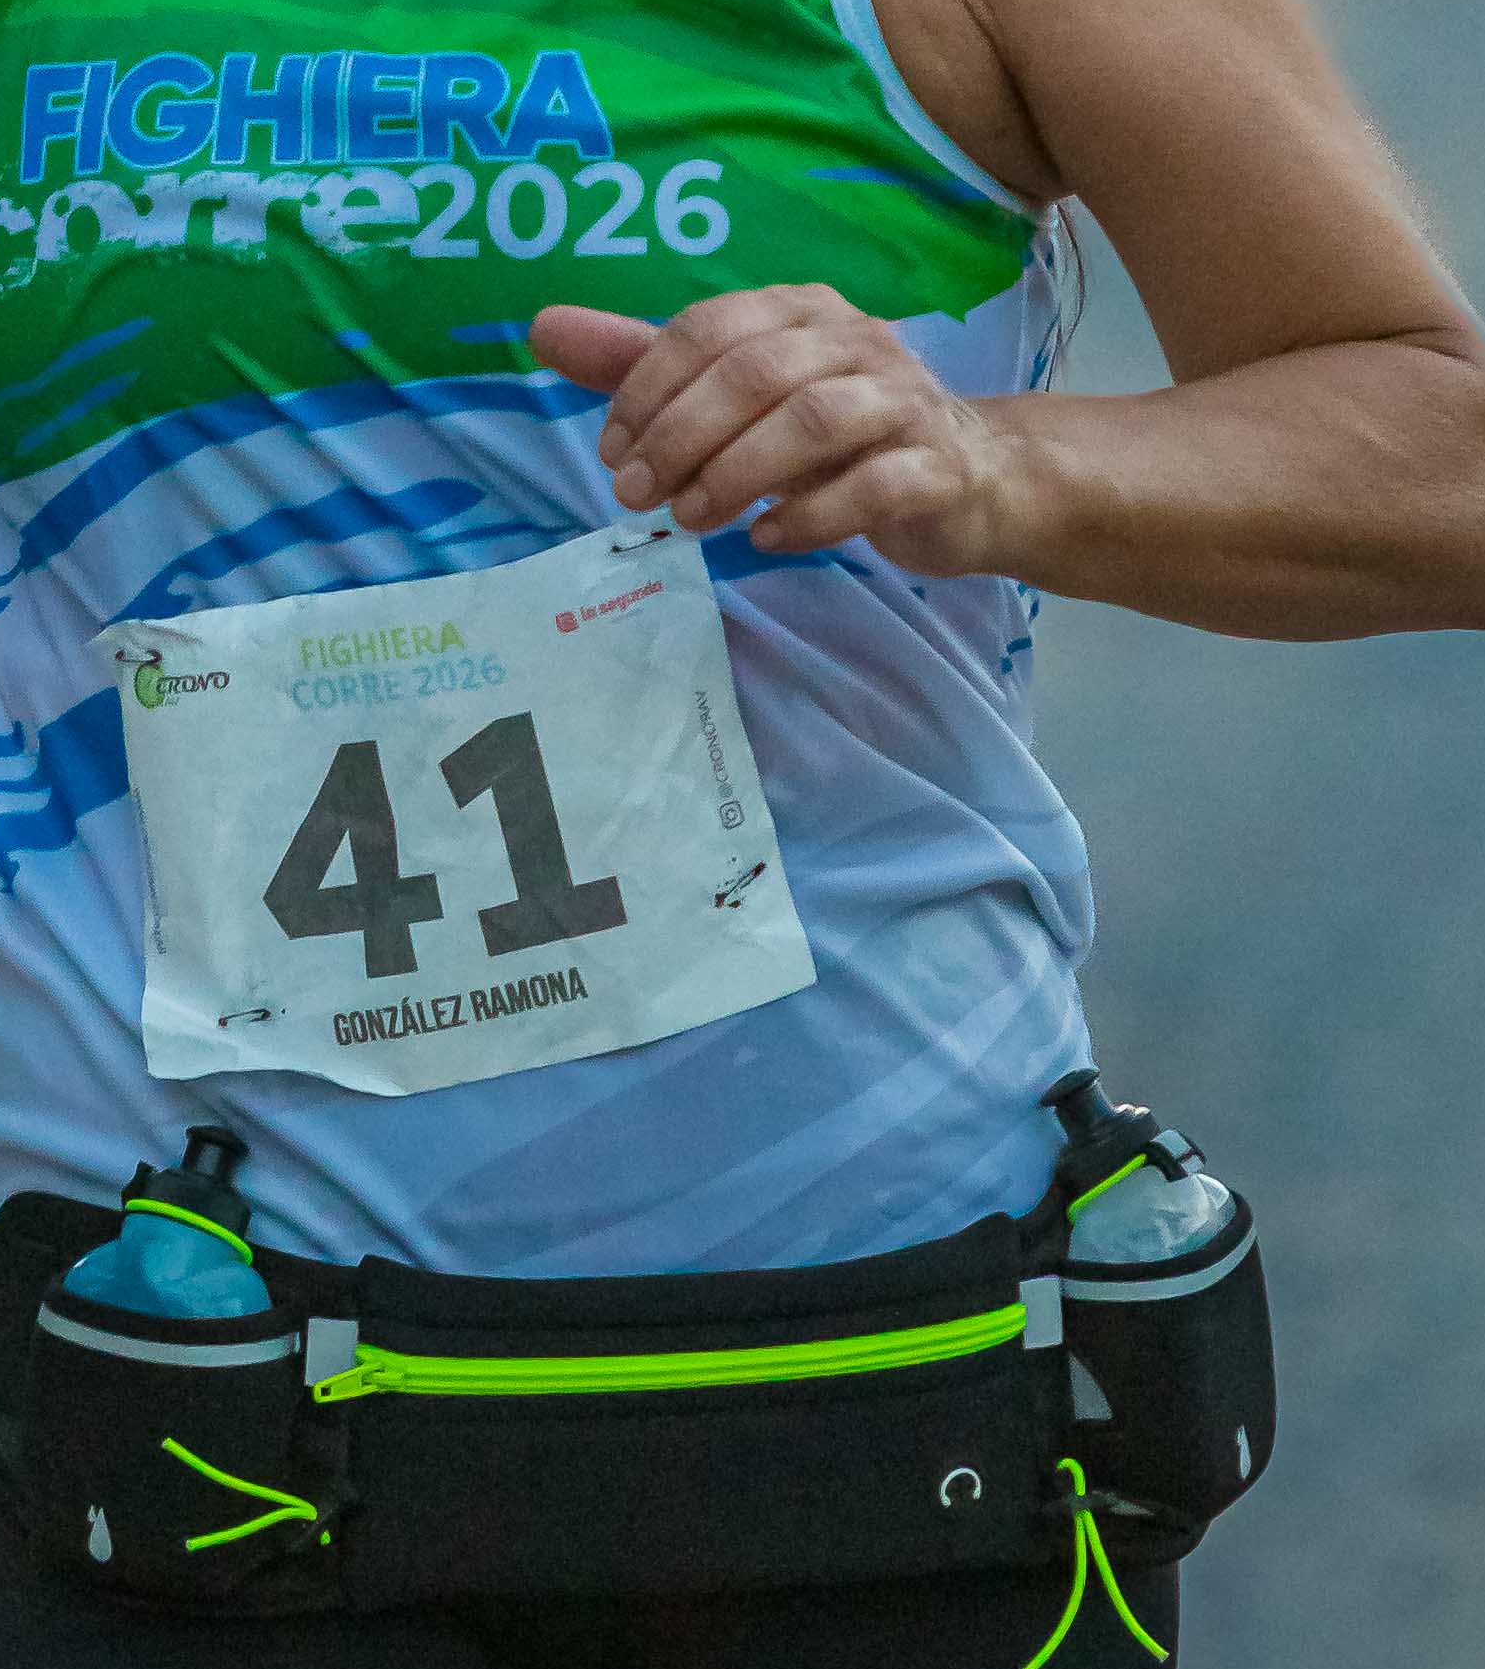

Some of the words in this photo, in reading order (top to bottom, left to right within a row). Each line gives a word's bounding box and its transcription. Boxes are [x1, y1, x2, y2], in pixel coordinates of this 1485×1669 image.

[19, 49, 615, 185] FIGHIERA
[291, 670, 405, 711] CORRE
[412, 652, 507, 700] 2026
[299, 619, 465, 670] FIGHIERA
[262, 710, 628, 980] 41
[331, 995, 468, 1047] GONZÁLEZ
[468, 965, 589, 1022] RAMONA
